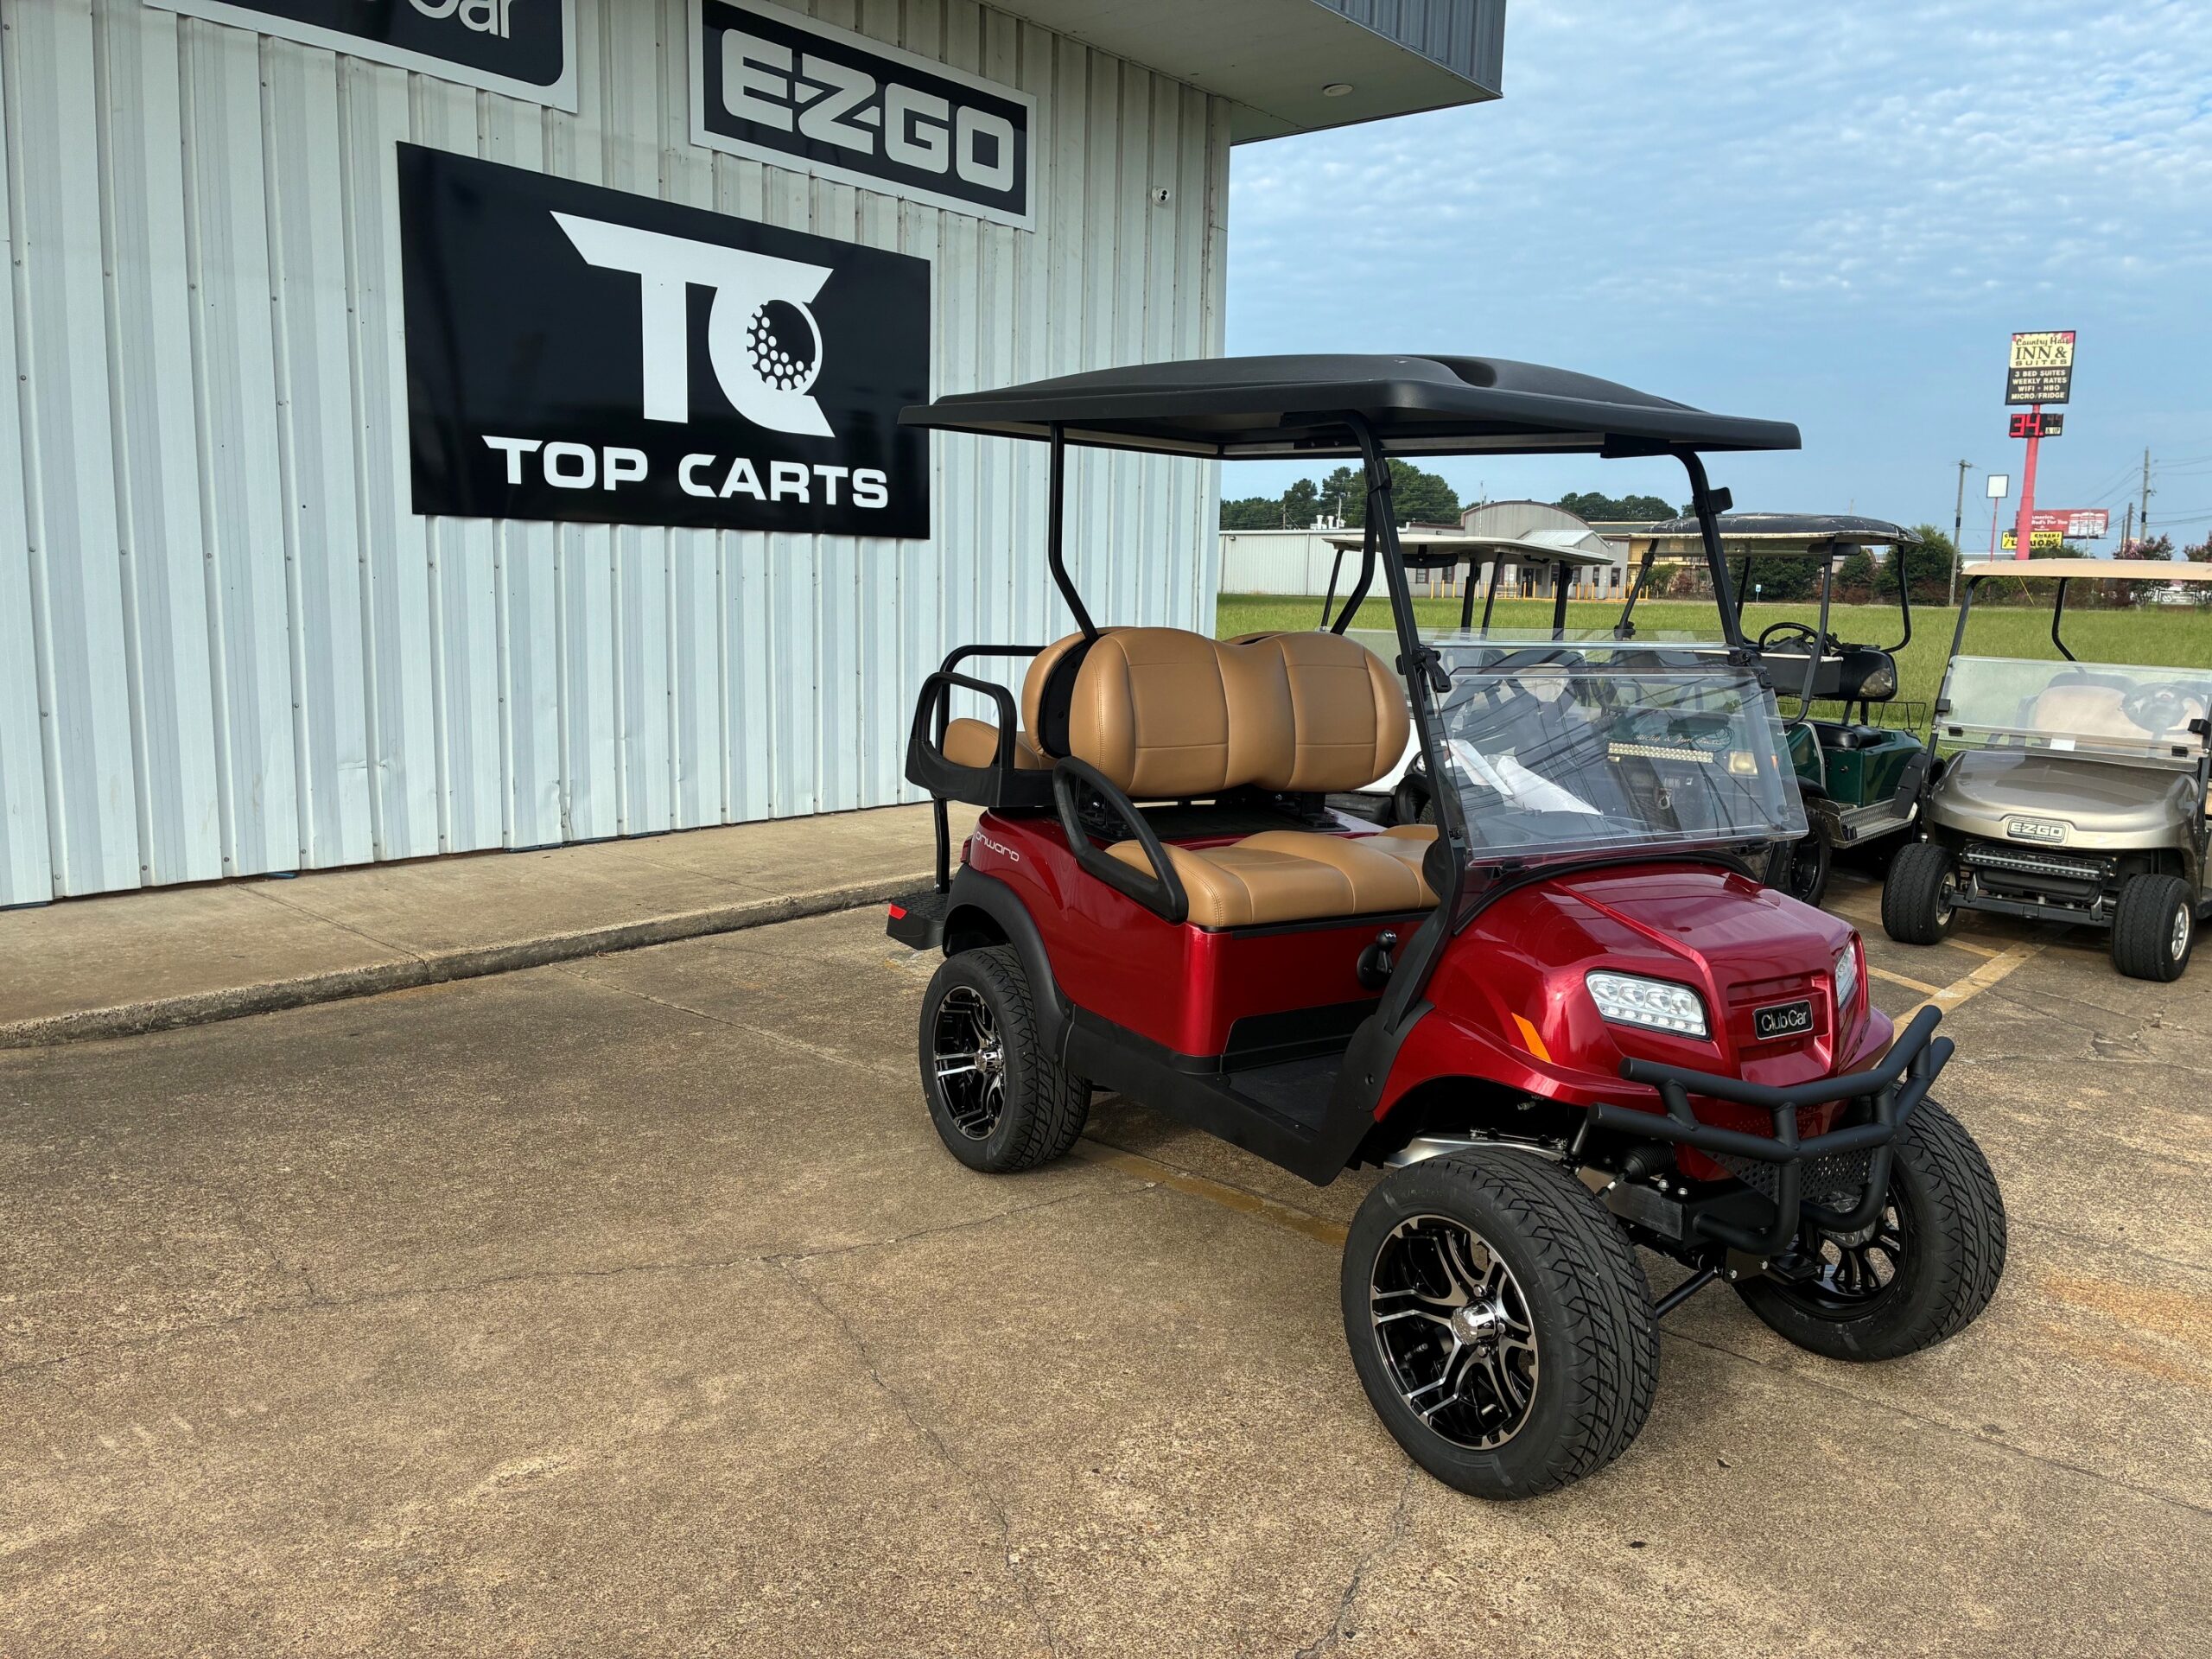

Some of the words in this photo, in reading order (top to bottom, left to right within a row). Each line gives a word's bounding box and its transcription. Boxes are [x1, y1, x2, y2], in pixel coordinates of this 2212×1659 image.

[410, 0, 509, 39] ar
[2015, 346, 2052, 359] INN
[2055, 346, 2067, 359] &
[481, 435, 648, 491] TOP
[678, 454, 888, 508] CARTS
[976, 830, 1020, 861] onward
